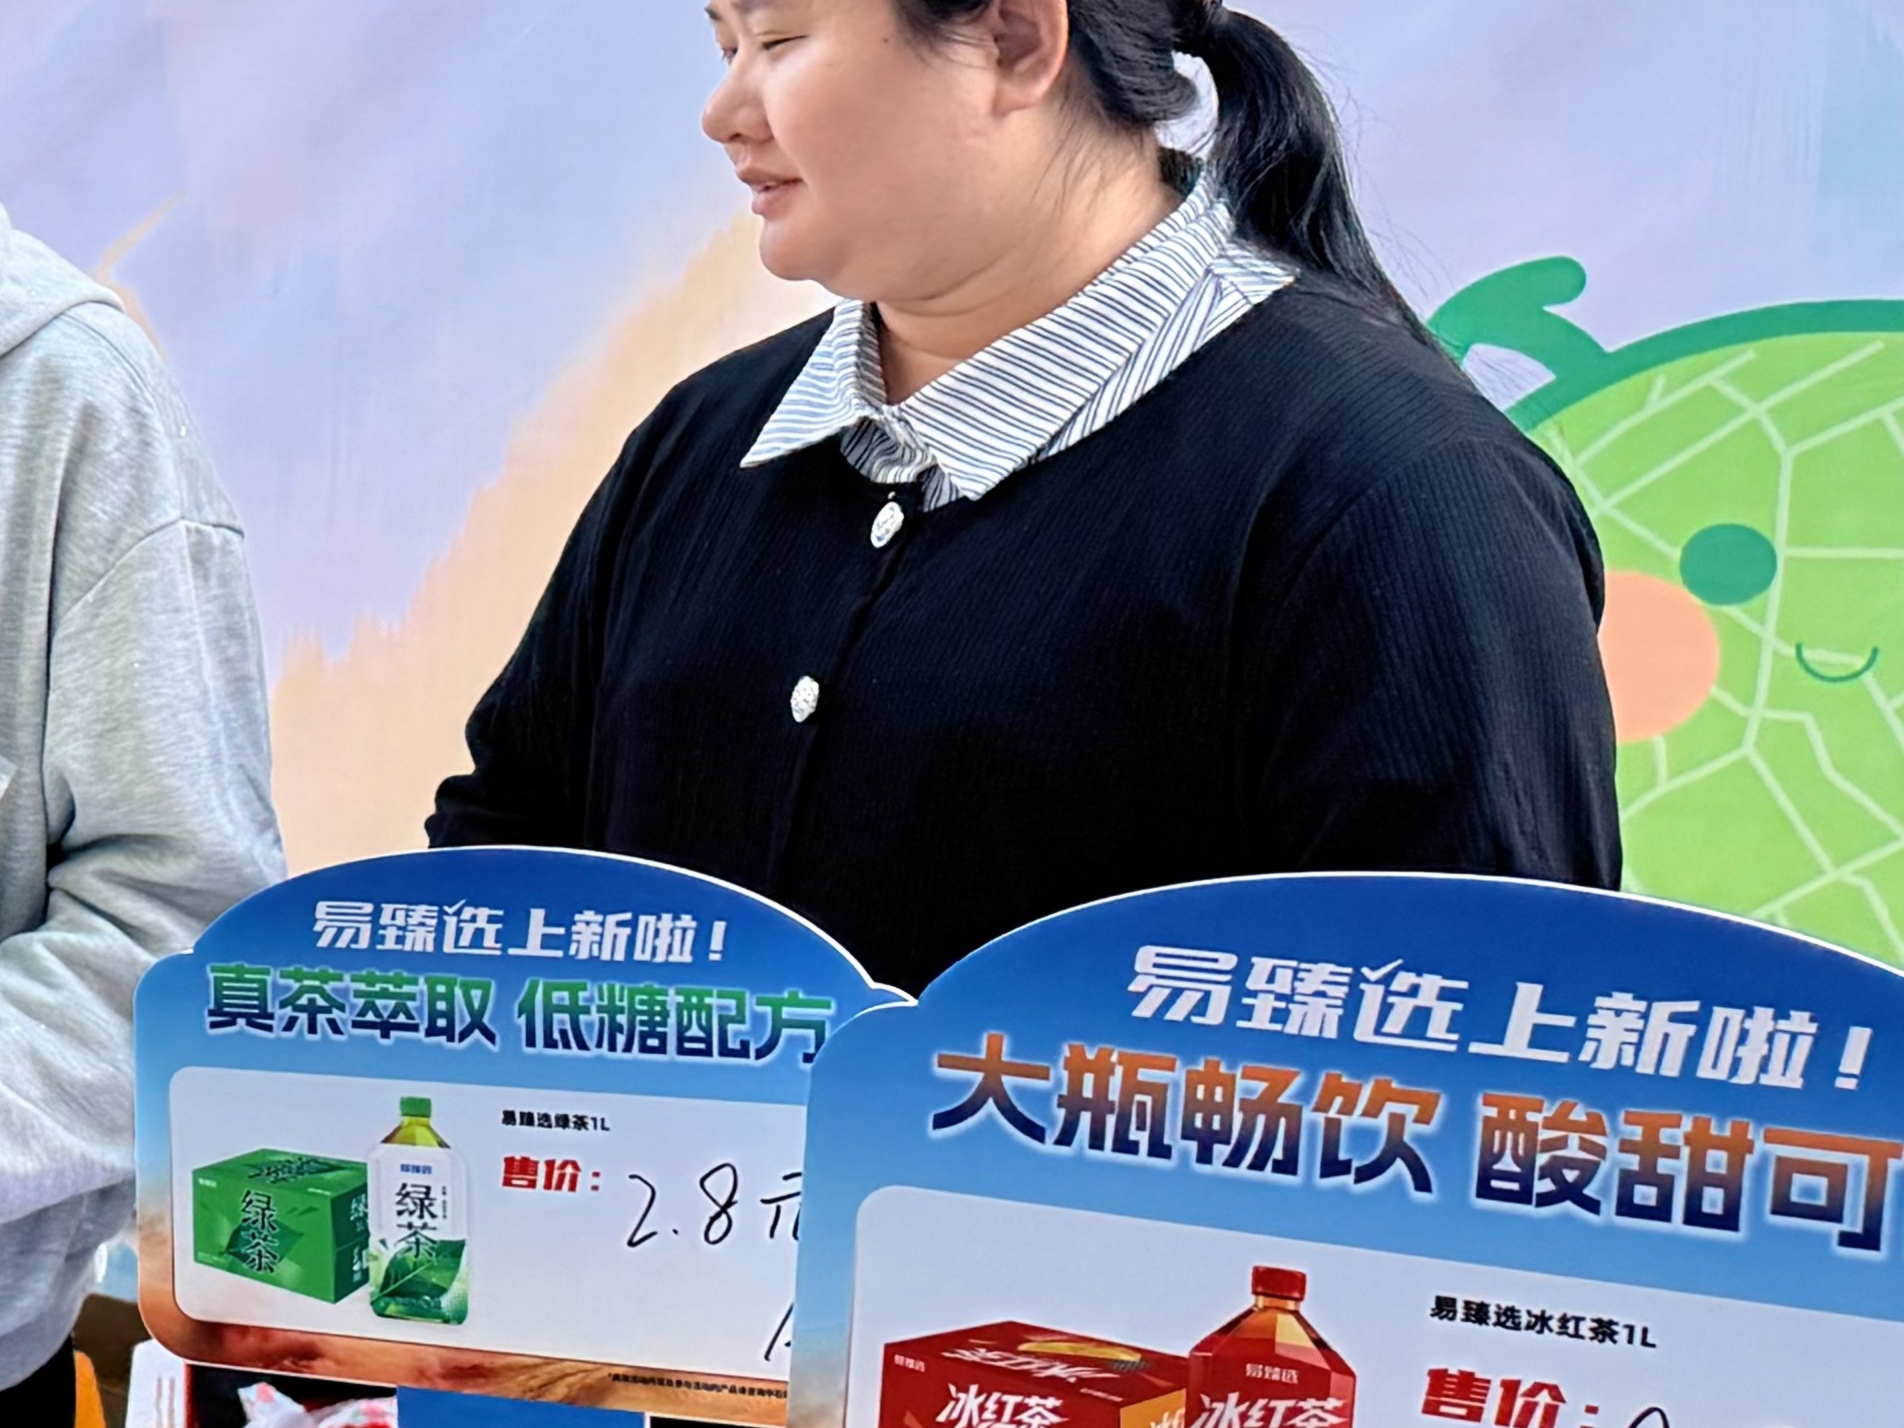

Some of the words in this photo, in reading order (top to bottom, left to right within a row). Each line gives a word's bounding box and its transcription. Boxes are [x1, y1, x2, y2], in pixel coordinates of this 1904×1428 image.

[312, 899, 728, 963] 易臻选上新啦!
[207, 962, 499, 1049] 真茶萃取
[515, 977, 835, 1066] 低糖配方
[1129, 943, 1873, 1092] 易臻选上新啦!
[501, 1109, 611, 1134] 易臻选绿茶1L
[930, 1031, 1445, 1202] 大瓶畅饮
[1474, 1089, 1904, 1259] 酸甜可
[501, 1155, 601, 1193] 售价:
[241, 1189, 279, 1274] 绿茶
[394, 1182, 439, 1262] 绿茶
[1430, 1293, 1658, 1350] 易臻选冰红茶1L
